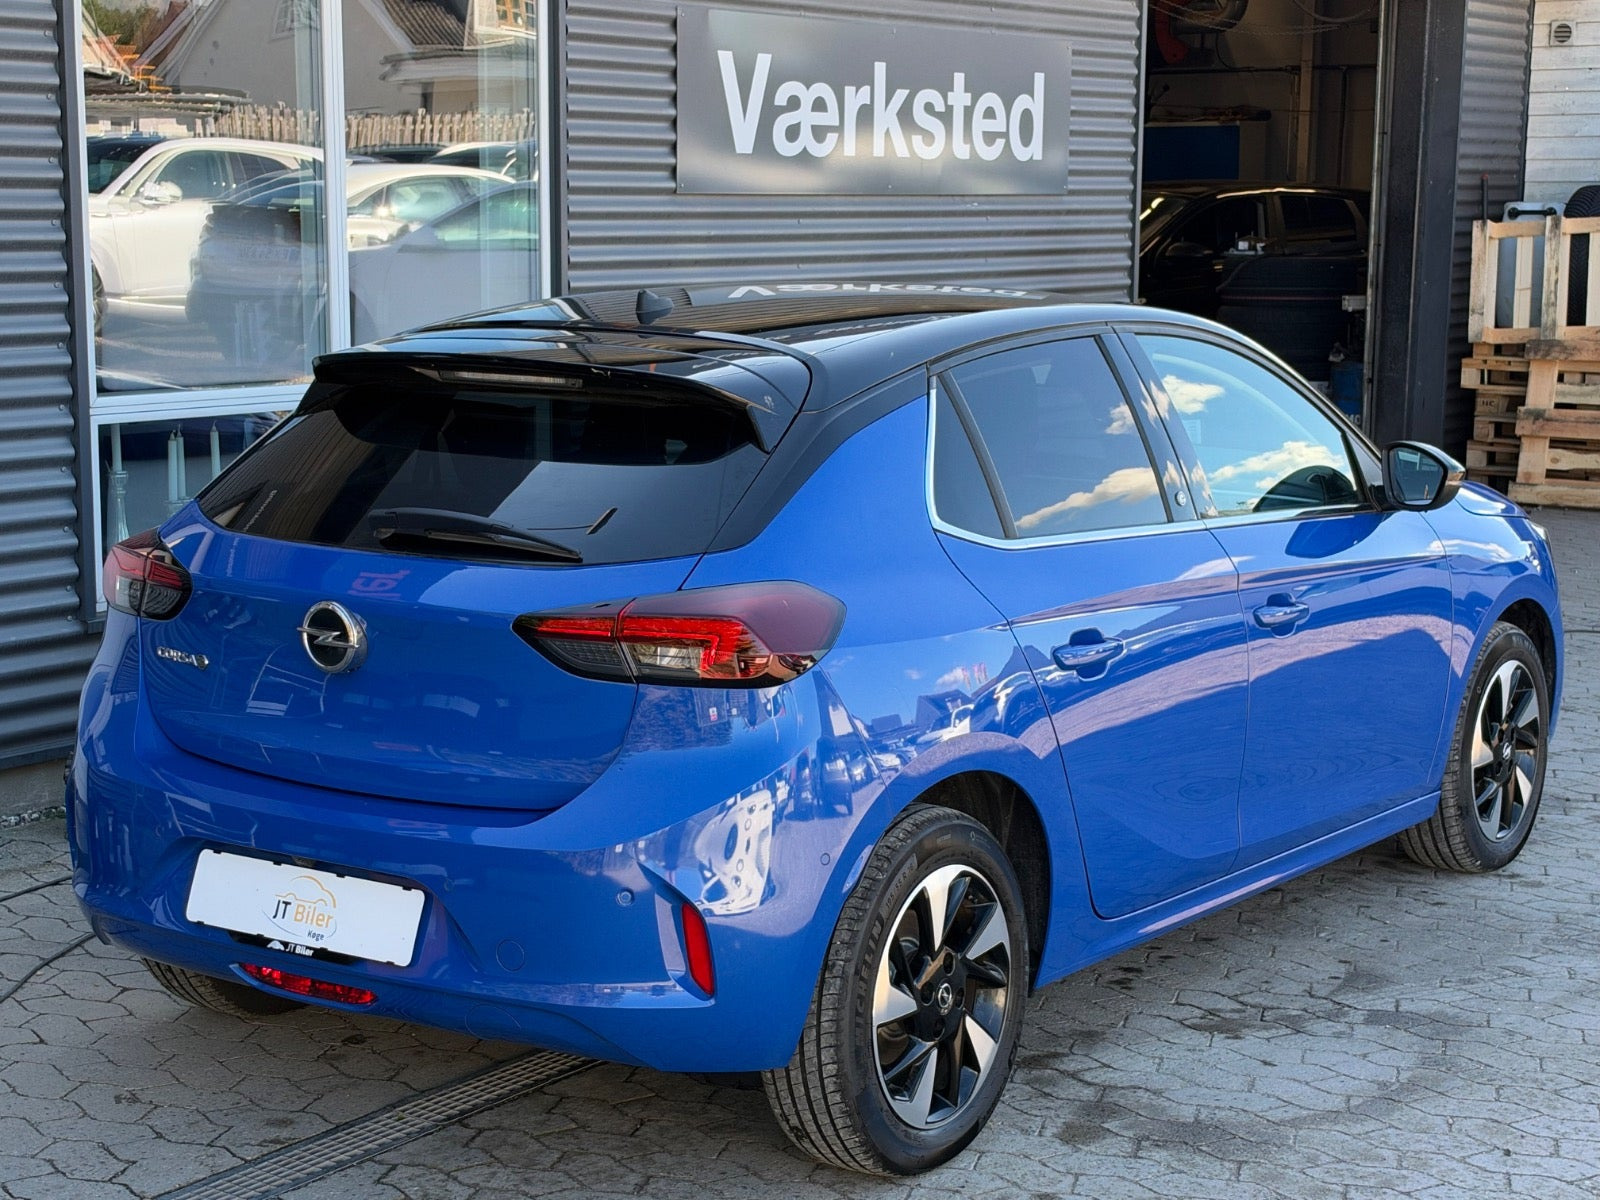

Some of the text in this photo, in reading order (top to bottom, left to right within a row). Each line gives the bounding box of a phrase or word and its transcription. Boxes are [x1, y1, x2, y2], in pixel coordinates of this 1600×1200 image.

[717, 50, 1045, 161] Værksted
[273, 900, 333, 928] JT Biler
[307, 929, 324, 941] Køge
[286, 943, 314, 957] JT Biler
